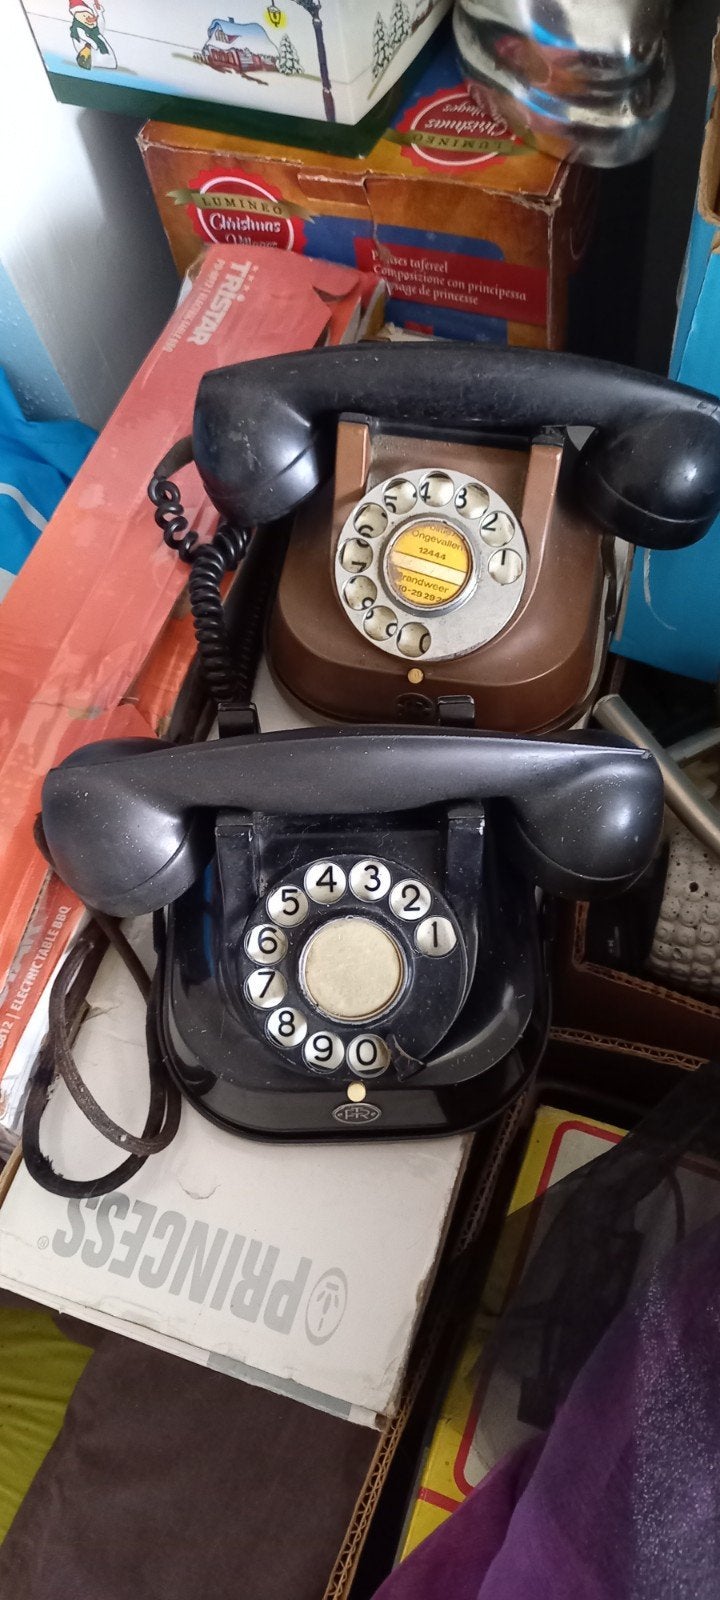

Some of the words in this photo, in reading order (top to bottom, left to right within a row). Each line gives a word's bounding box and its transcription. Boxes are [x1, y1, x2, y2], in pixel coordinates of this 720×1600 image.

[412, 133, 501, 149] LUMINEO
[202, 197, 282, 215] LUMINEO
[419, 283, 431, 297] de
[433, 289, 479, 306] princesse
[447, 279, 465, 290] con
[468, 281, 527, 301] principessa
[420, 482, 431, 502] 4
[456, 487, 467, 509] 3
[482, 513, 498, 532] 2
[419, 547, 446, 560] 12444
[315, 865, 337, 893] 4
[364, 864, 381, 892] 3
[281, 888, 300, 916] 5
[401, 884, 421, 911] 2
[257, 927, 278, 954] 6
[431, 921, 439, 948] 1
[11, 958, 43, 1011] ELECTRIC
[38, 930, 60, 961] TABLE
[53, 905, 72, 929] BBQ
[257, 971, 276, 999] 7
[278, 1010, 296, 1037] 8
[313, 1035, 333, 1062] 9
[356, 1038, 377, 1066] 0
[51, 1191, 313, 1335] PRINCESS
